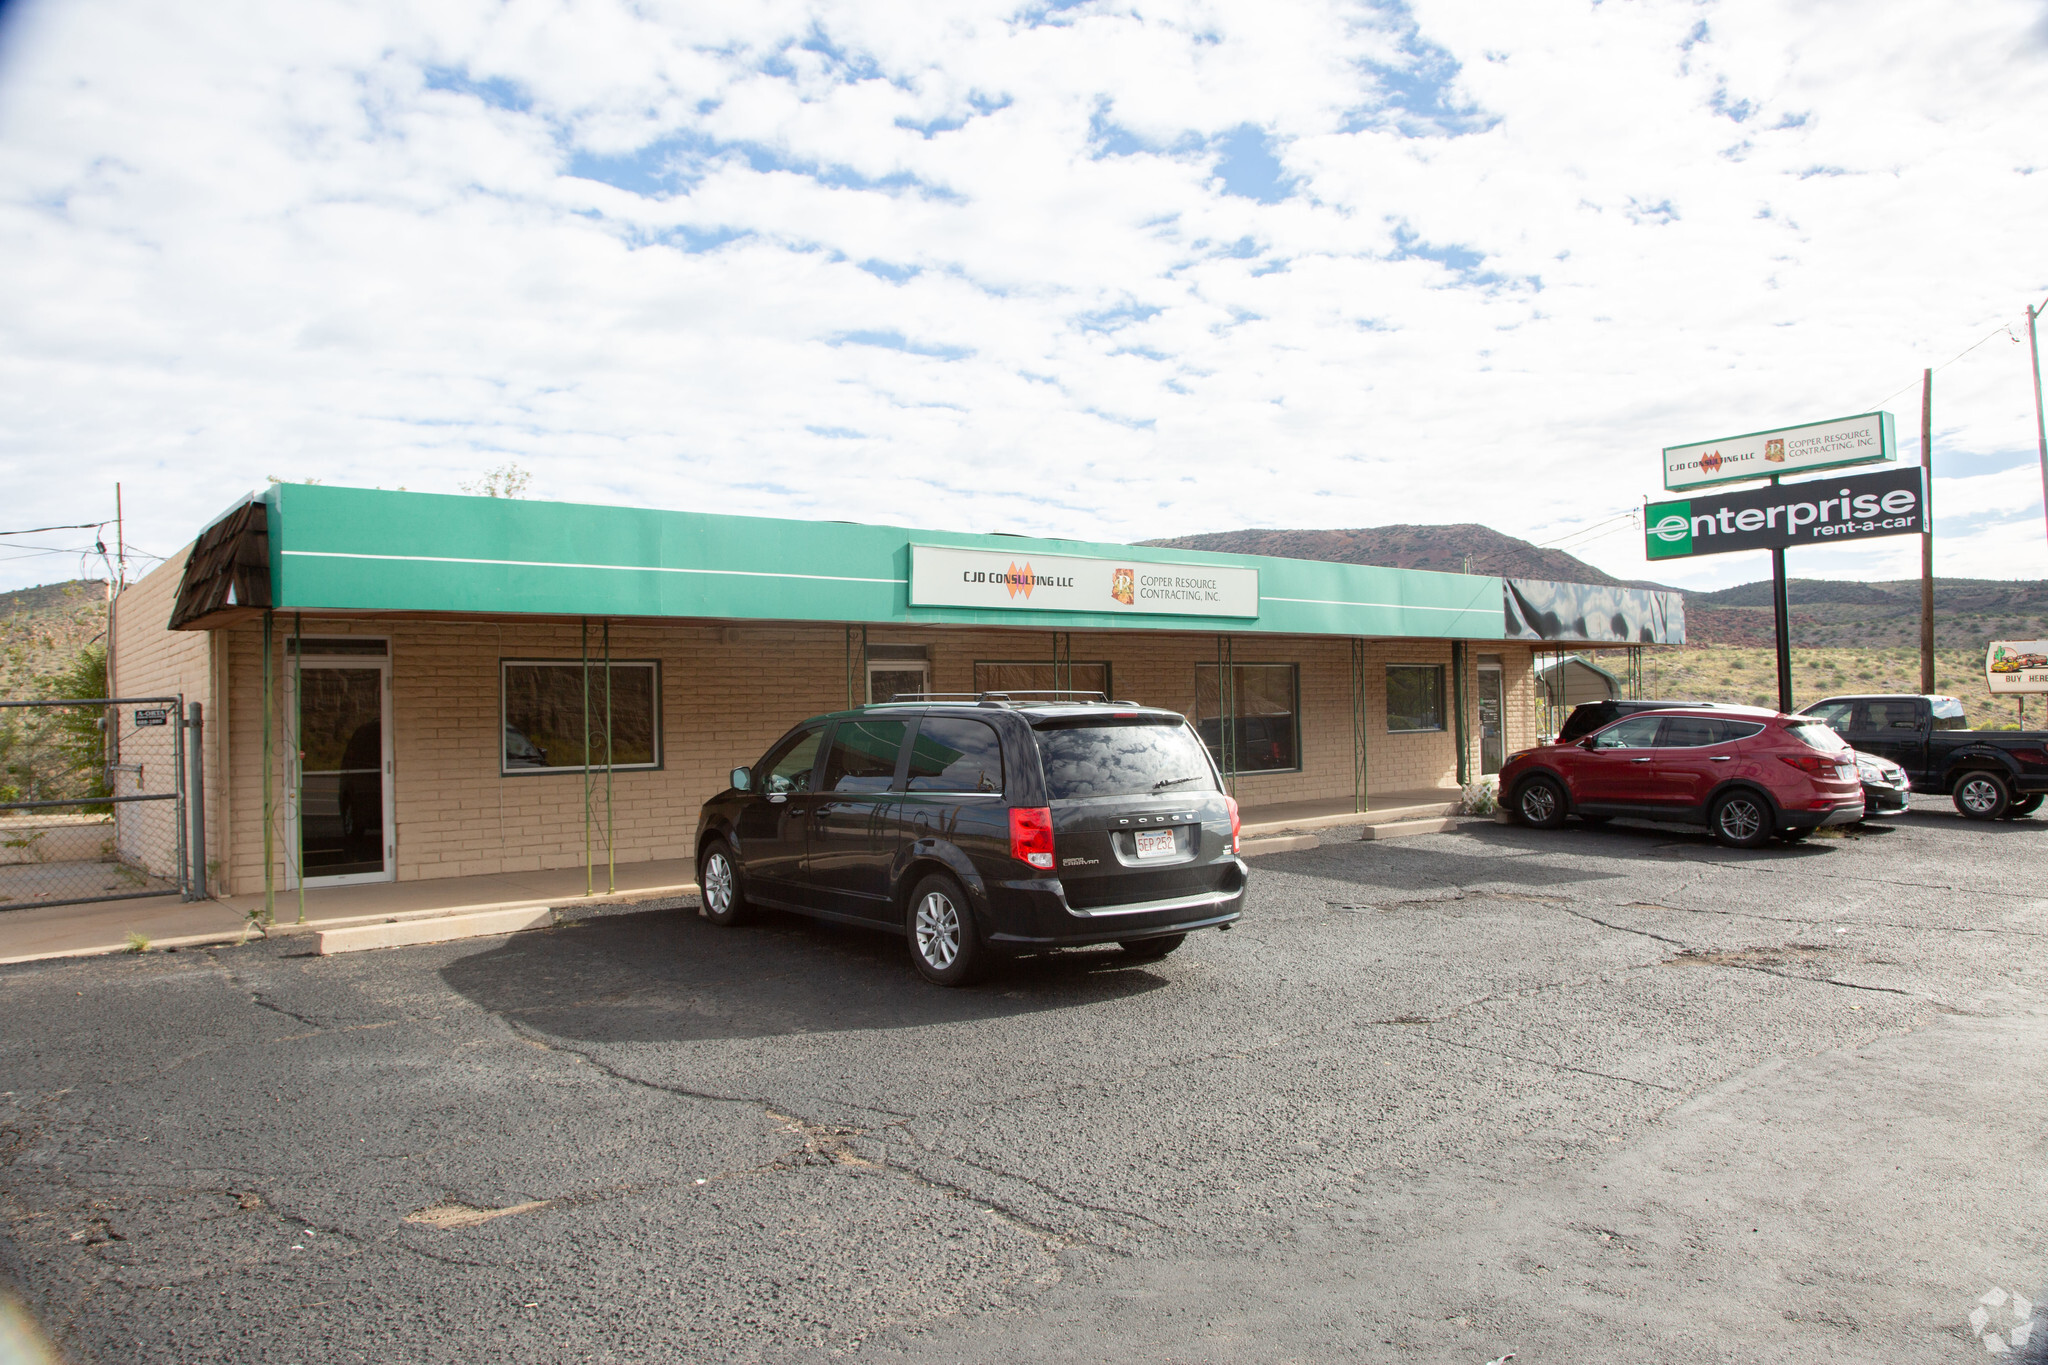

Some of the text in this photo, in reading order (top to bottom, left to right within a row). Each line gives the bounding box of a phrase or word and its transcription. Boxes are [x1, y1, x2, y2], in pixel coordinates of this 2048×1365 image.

[1788, 429, 1871, 449] COPPER RESOURCE
[1788, 442, 1854, 458] CONTRACTING,
[1857, 436, 1876, 449] INC.
[1669, 451, 1755, 472] CJD CONSULTING LLC
[1646, 488, 1916, 542] enterprise
[1813, 515, 1916, 537] rent-a-car
[963, 571, 1074, 588] CJD CONSULTING LLC
[1140, 575, 1217, 590] COPPER RESOURCE
[1140, 587, 1221, 602] CONTRACTING, INC.
[1119, 814, 1193, 824] DODGE
[1138, 836, 1174, 852] 5EP 252
[1063, 859, 1100, 867] CARAVAN
